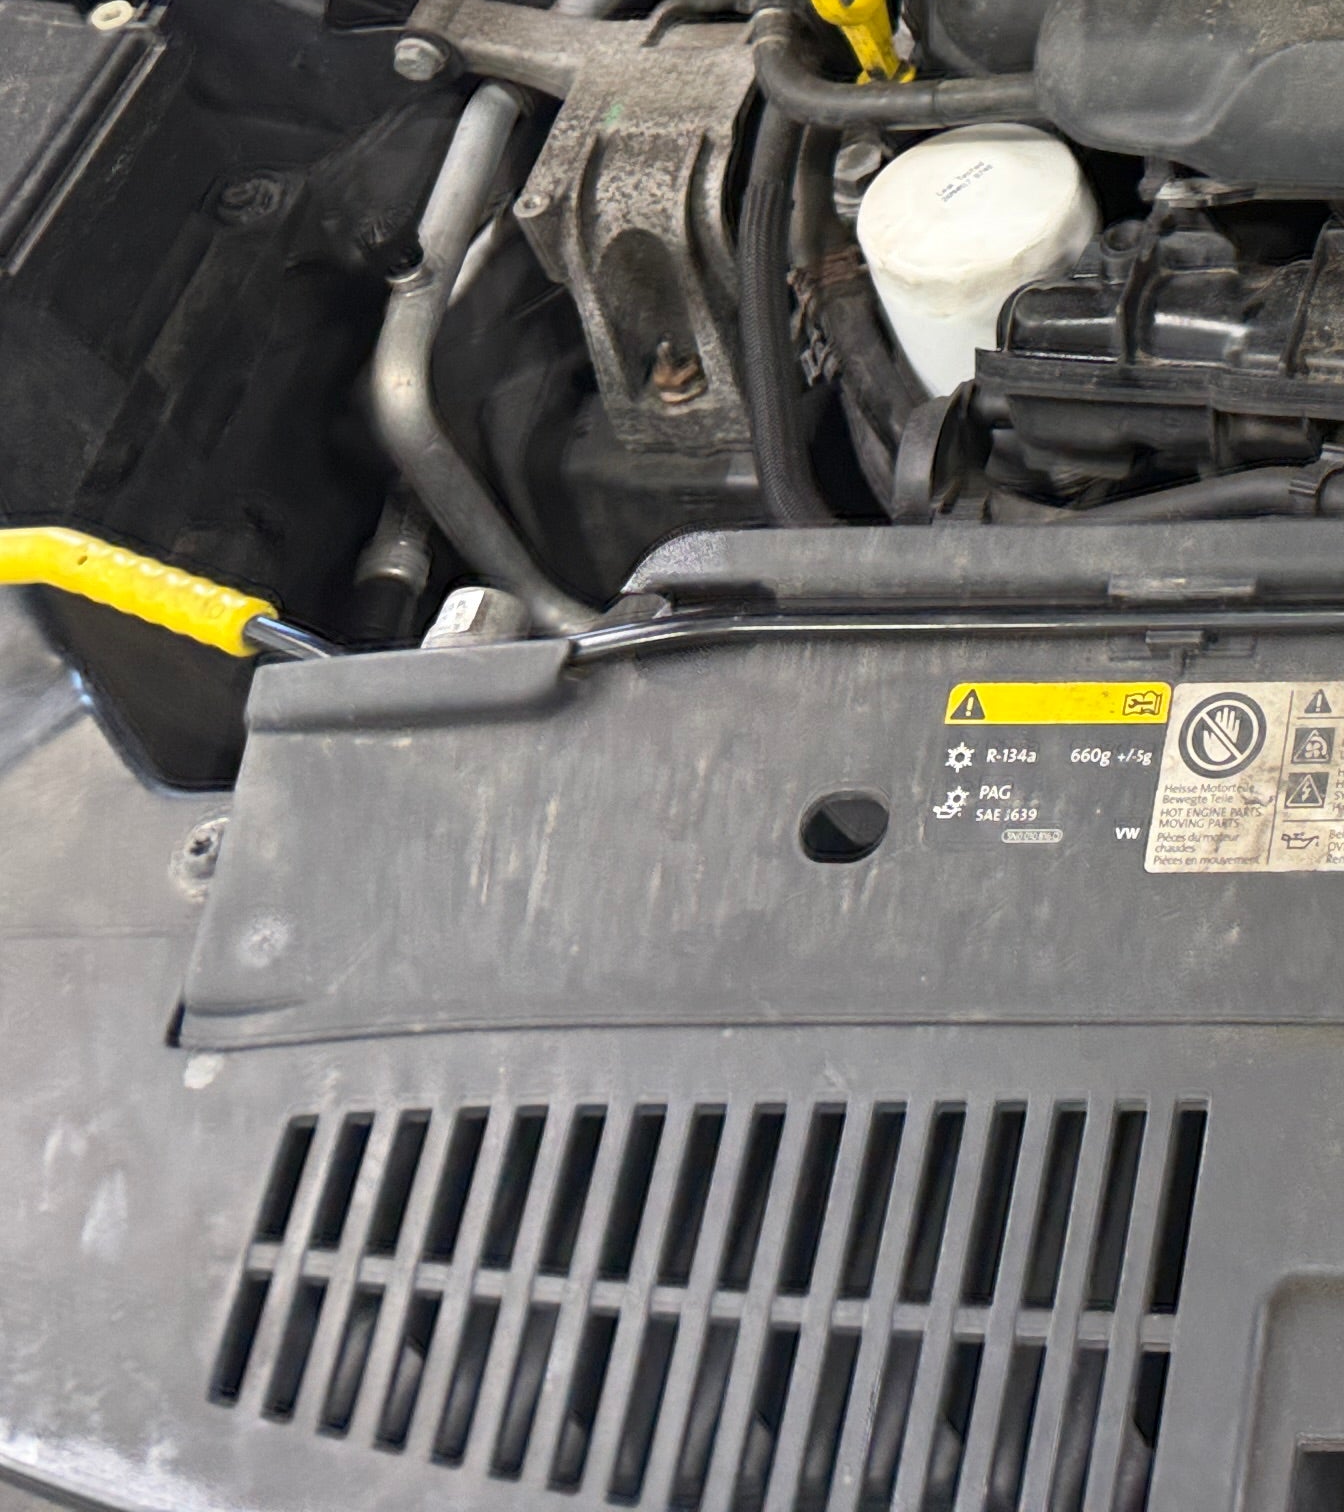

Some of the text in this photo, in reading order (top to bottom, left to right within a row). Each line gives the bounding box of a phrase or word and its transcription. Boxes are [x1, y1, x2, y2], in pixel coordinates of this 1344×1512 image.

[986, 748, 1037, 763] R-134a
[1070, 748, 1111, 767] 660g
[979, 785, 1011, 800] PAG
[975, 809, 1000, 822] SAE
[1160, 808, 1262, 817] HOT ENGINE PARTS
[1159, 819, 1240, 828] MOVING PARTS
[1115, 827, 1141, 840] VW
